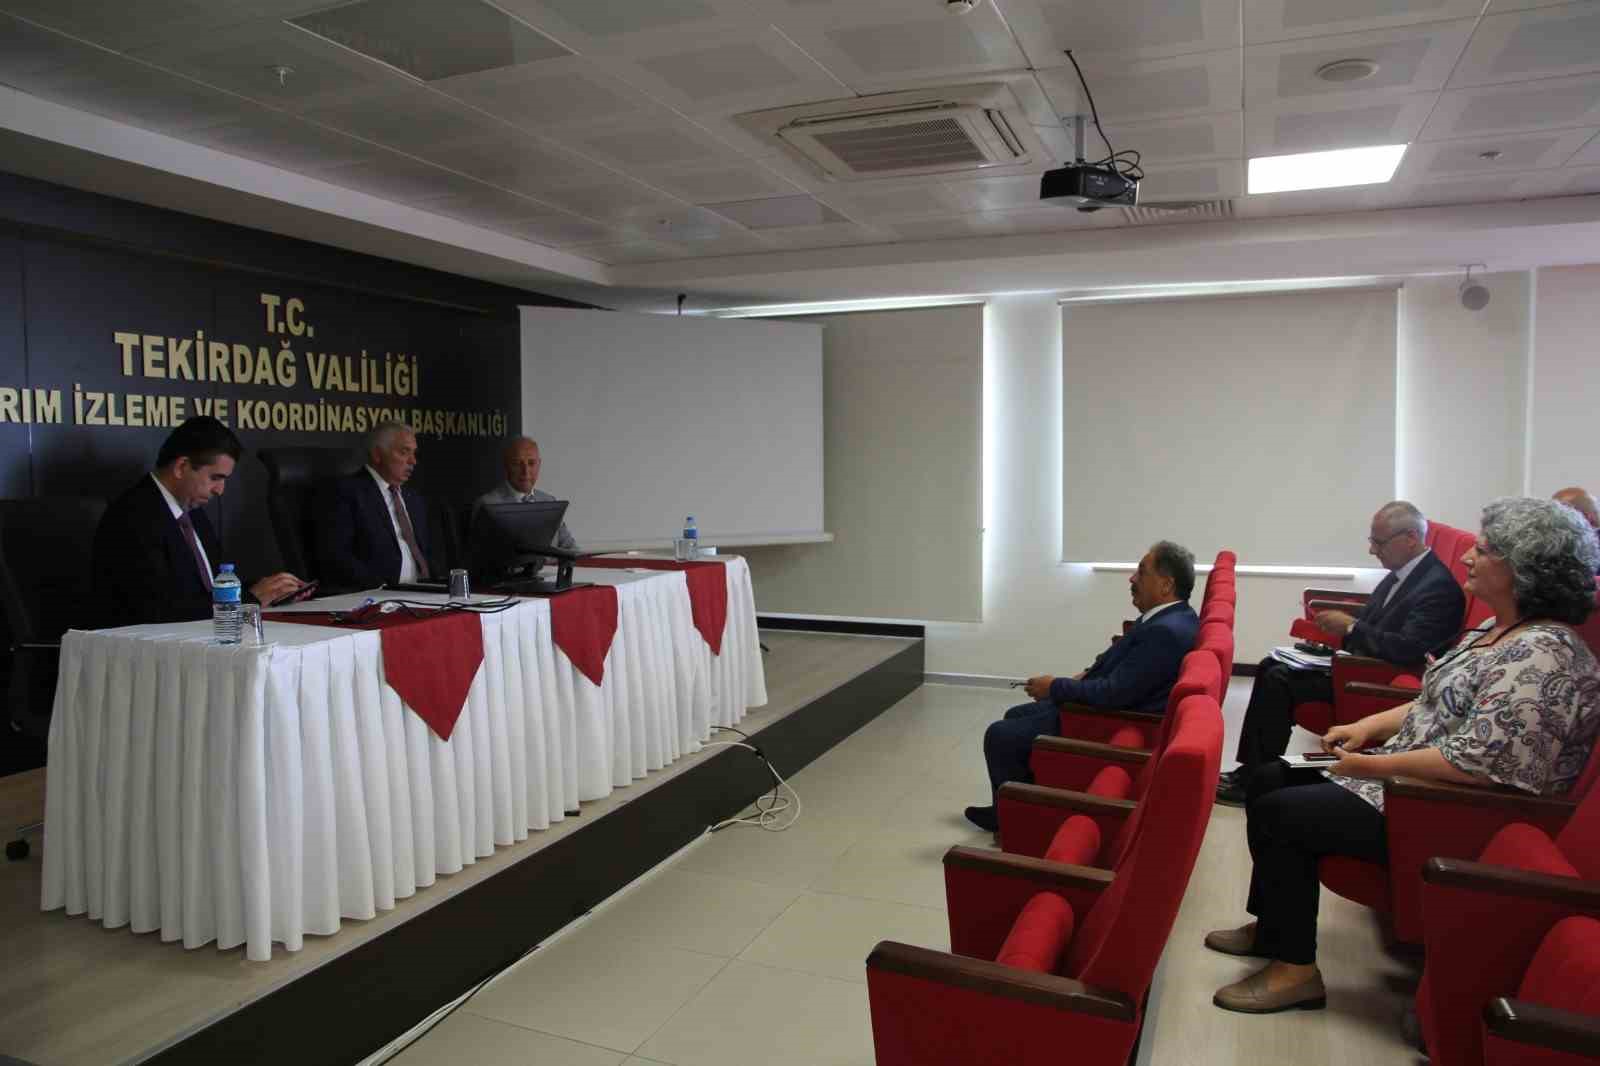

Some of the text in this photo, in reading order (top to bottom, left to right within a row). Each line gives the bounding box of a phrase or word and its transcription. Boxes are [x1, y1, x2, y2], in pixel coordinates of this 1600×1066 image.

[261, 293, 314, 337] T.C.
[114, 330, 418, 397] TEKİRDAĞ VALİLİĞİ
[74, 383, 185, 427] İZLEME
[193, 398, 229, 428] VE
[412, 409, 507, 440] BAŞKANLIĞI
